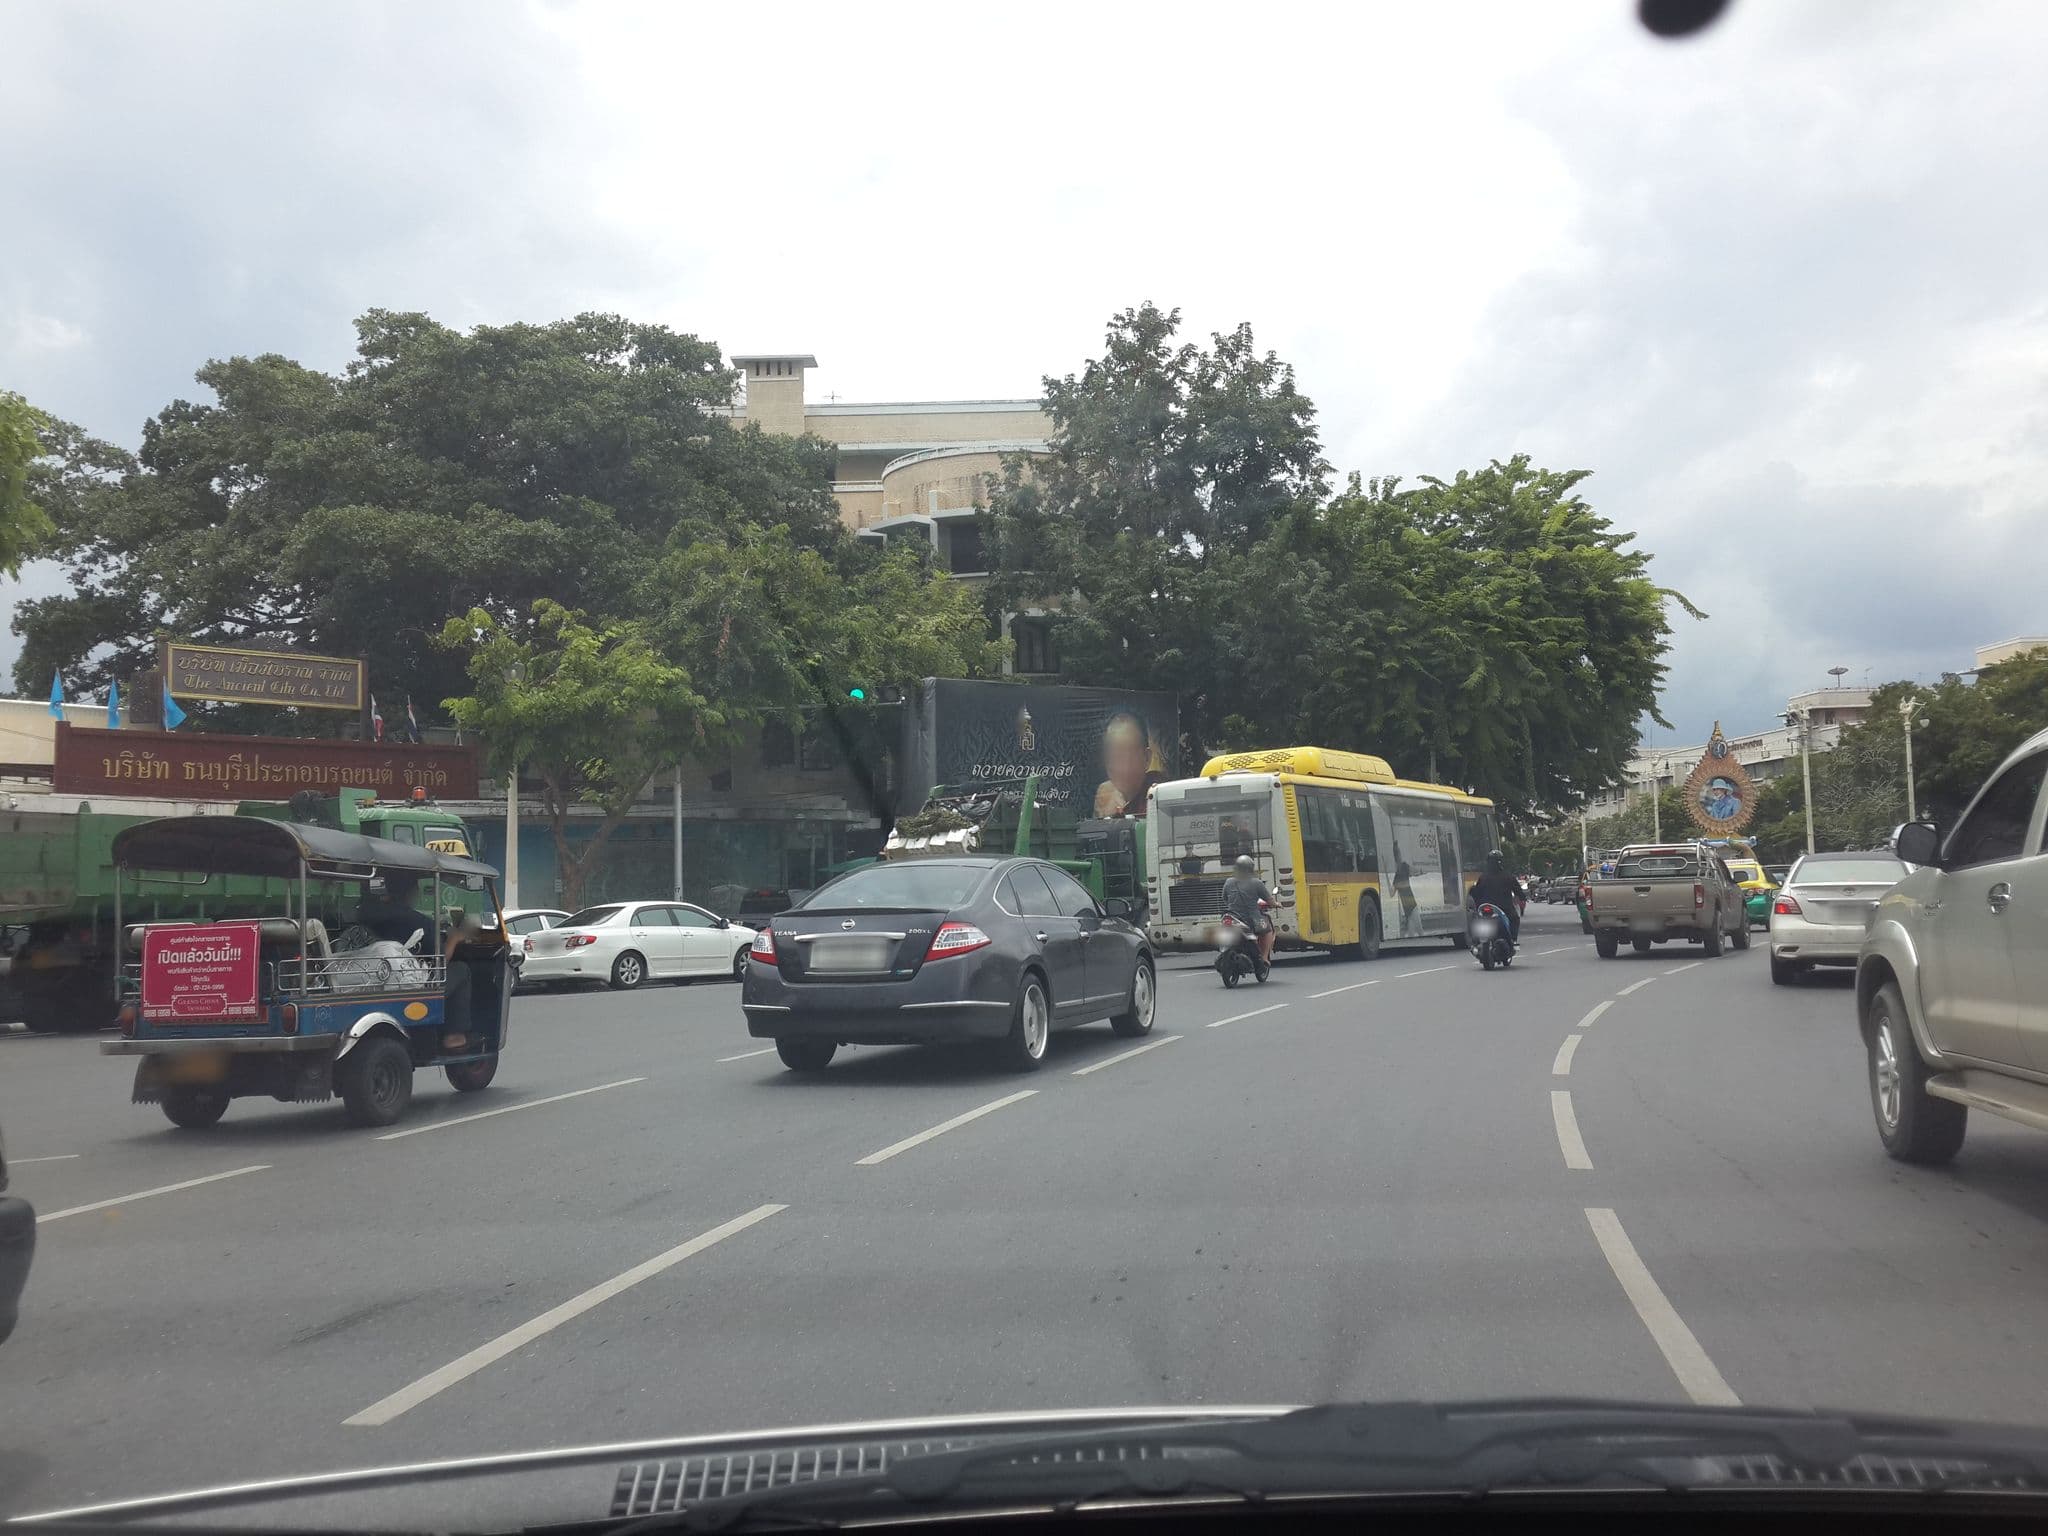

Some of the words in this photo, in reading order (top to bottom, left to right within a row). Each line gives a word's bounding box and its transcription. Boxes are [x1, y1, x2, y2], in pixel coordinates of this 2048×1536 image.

[178, 653, 226, 673] บริษัท
[183, 673, 211, 689] The
[216, 677, 266, 693] Ancient
[270, 680, 296, 695] City
[102, 750, 169, 779] บริษัท
[182, 753, 393, 790] ธนบุรีประกอบรถยนต์
[403, 761, 449, 786] จำกัด
[972, 761, 1075, 780] ถวายความอาลัย
[427, 841, 456, 853] TAXI
[158, 943, 241, 964] เปิดแล้ววันนี้!!!
